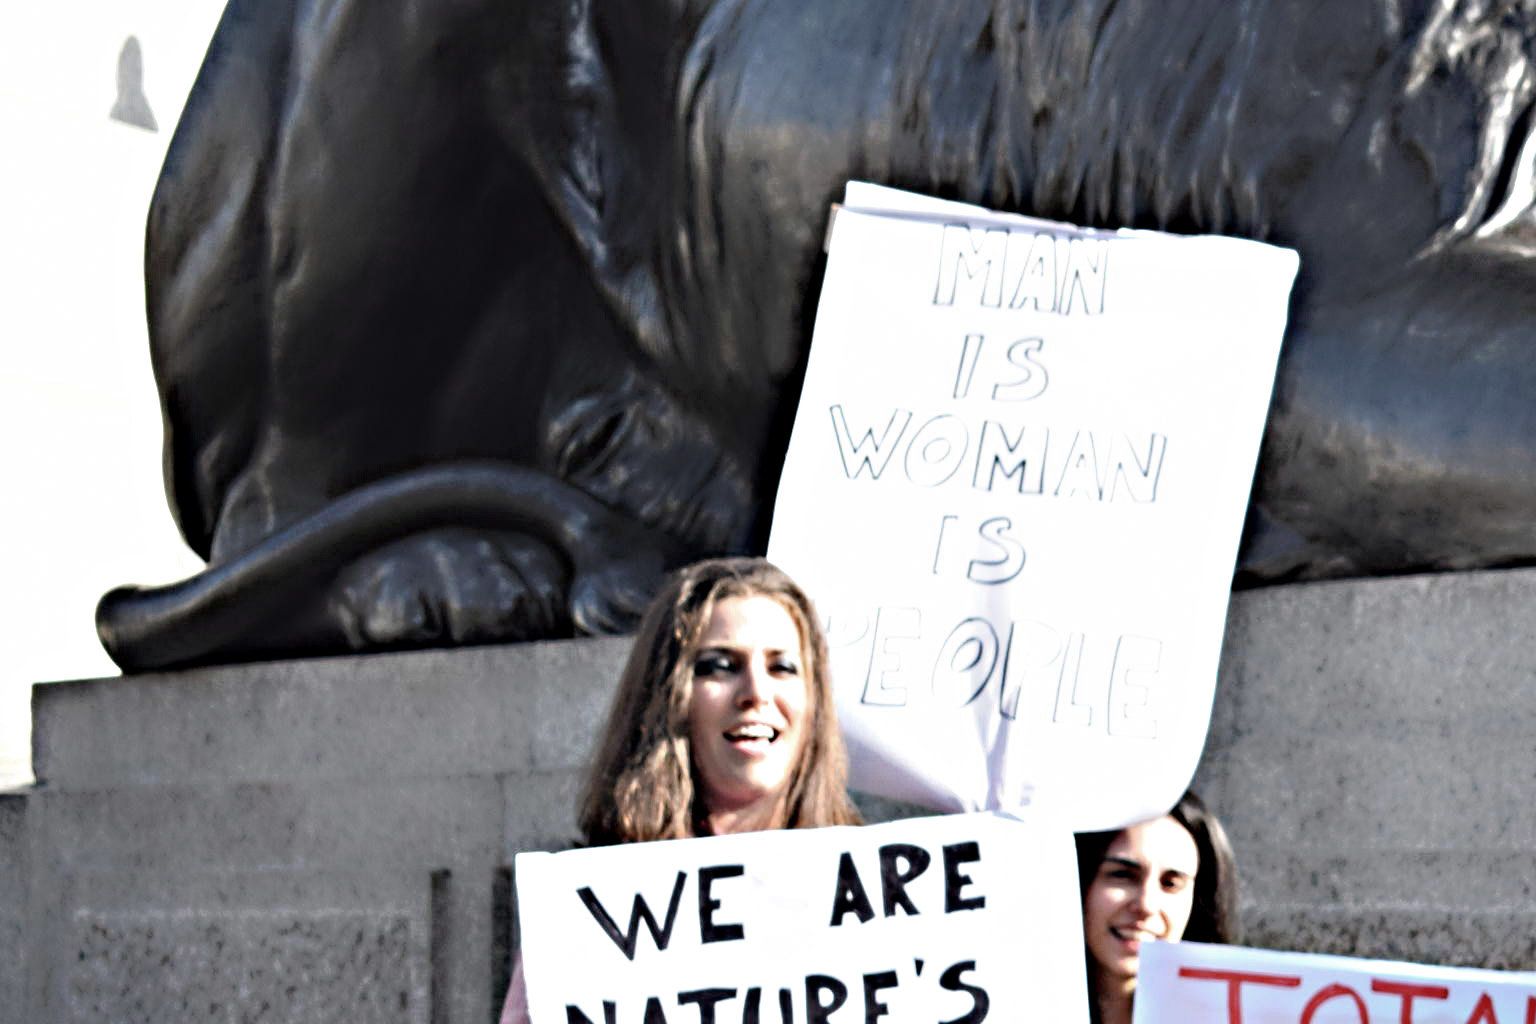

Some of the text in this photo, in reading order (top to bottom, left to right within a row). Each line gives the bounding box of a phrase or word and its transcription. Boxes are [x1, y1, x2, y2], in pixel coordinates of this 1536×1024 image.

[932, 223, 1108, 316] MAN
[953, 334, 1049, 400] IS
[829, 404, 1168, 503] WOMAN
[932, 514, 1027, 586] IS
[577, 842, 985, 960] WE ARE
